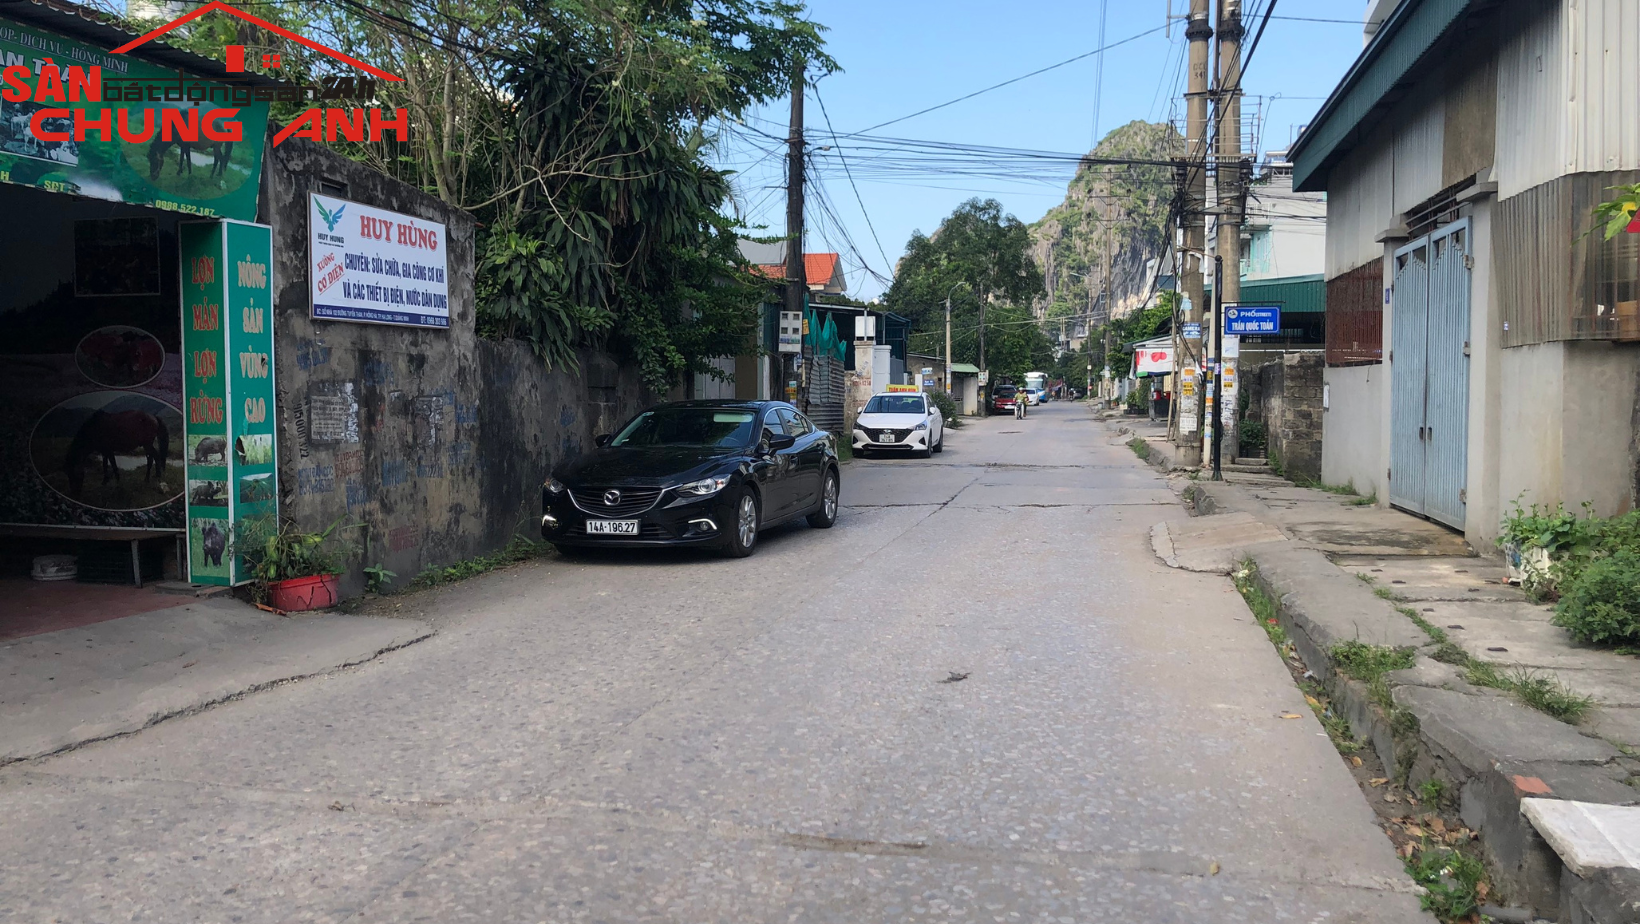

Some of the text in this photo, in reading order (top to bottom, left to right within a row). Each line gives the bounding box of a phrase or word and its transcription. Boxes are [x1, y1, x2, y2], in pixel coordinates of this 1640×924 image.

[103, 57, 128, 72] MINH
[317, 232, 329, 241] HUY
[360, 215, 438, 252] HUY HÙNG
[191, 254, 215, 290] LỢN
[237, 254, 267, 289] NÔNG
[344, 252, 371, 273] CHUYÊN:
[372, 253, 384, 275] SỬA
[402, 262, 412, 279] GIA
[412, 261, 427, 281] CÔNG
[428, 266, 435, 282] CƠ
[435, 265, 445, 284] KHÍ
[342, 279, 352, 299] VÀ
[352, 280, 365, 301] CÁC
[366, 281, 382, 303] THIẾT
[383, 286, 390, 307] BỊ
[406, 288, 420, 307] NƯỚC
[421, 289, 433, 308] DÂN
[433, 293, 448, 312] DỤNG
[193, 297, 219, 331] MÁN
[242, 297, 264, 334] SẢN
[1240, 309, 1256, 317] PHỐ
[1245, 319, 1259, 331] QUỐC
[1260, 319, 1274, 331] TOẢN
[194, 348, 217, 384] LỢN
[190, 390, 223, 424] RỪNG
[245, 397, 266, 424] CAO
